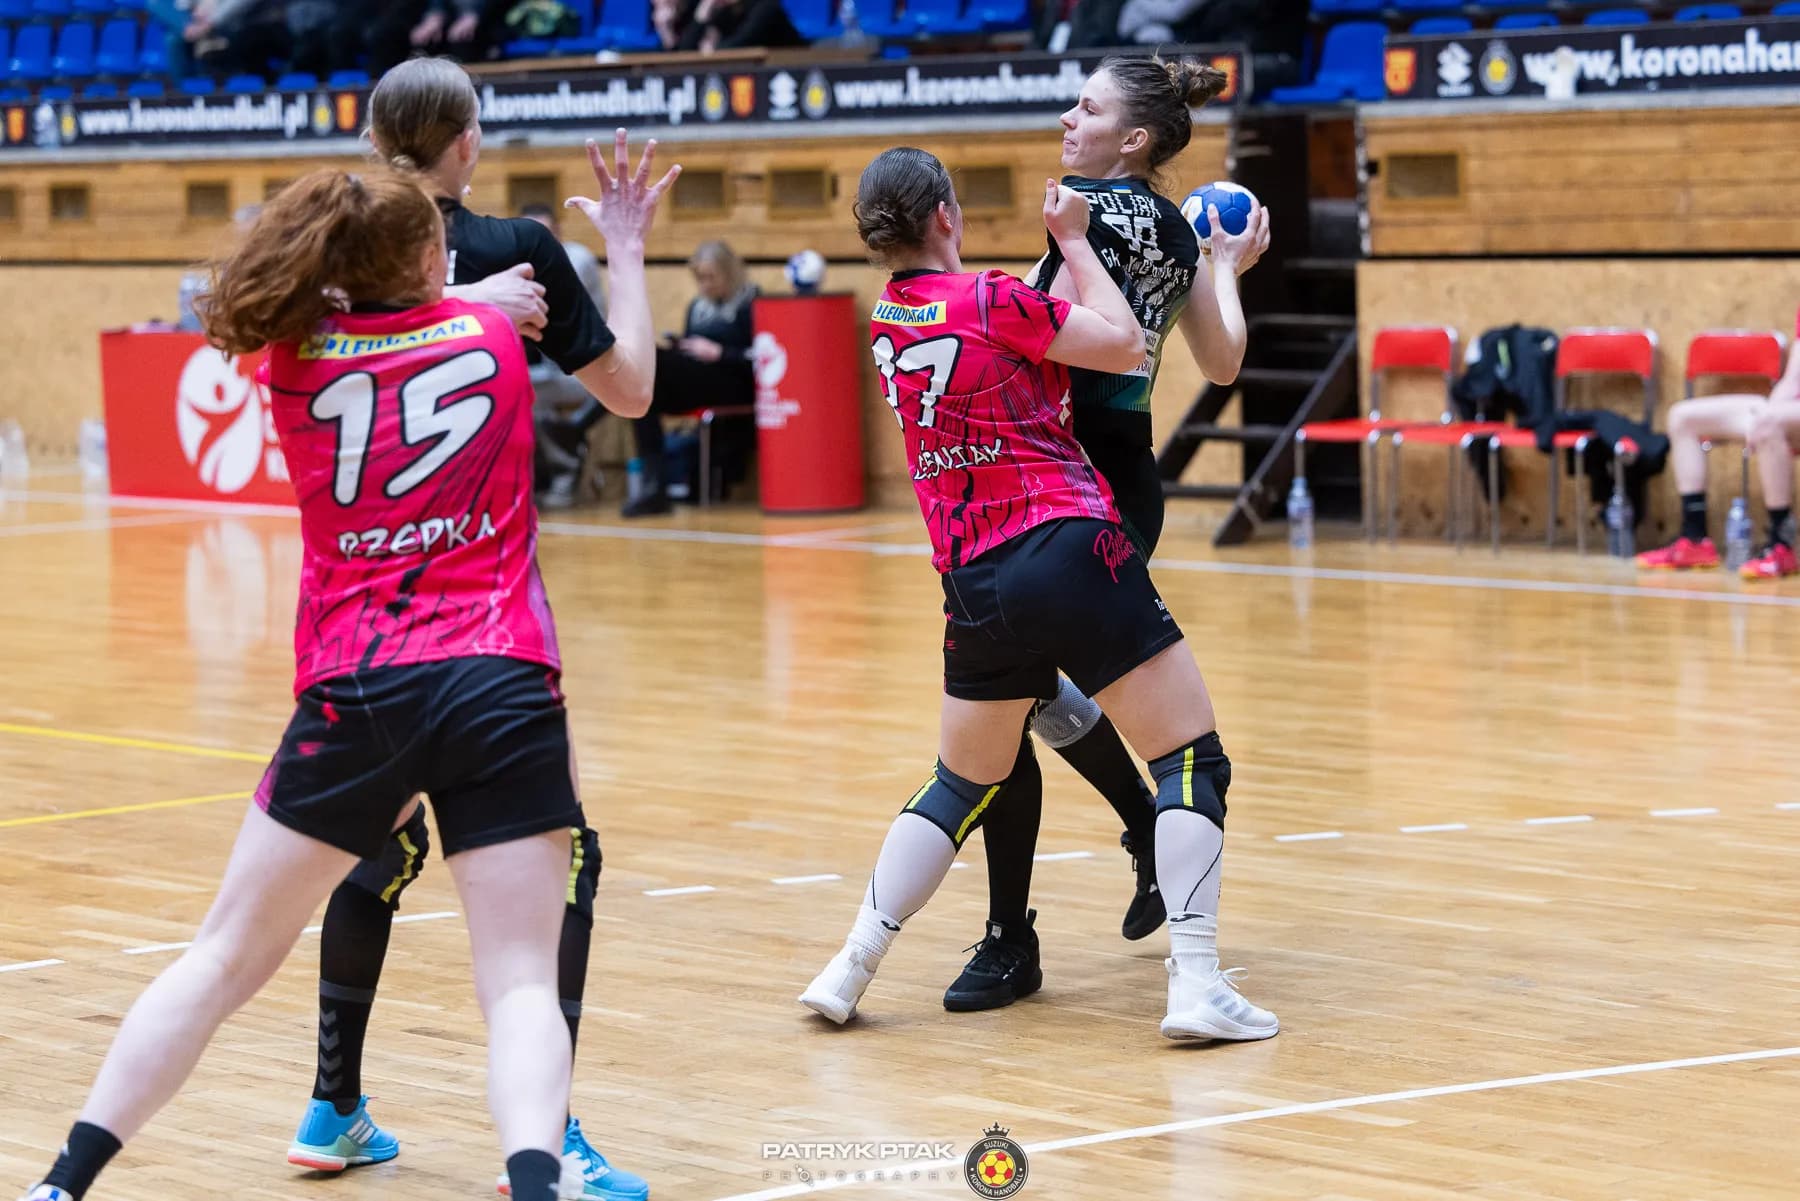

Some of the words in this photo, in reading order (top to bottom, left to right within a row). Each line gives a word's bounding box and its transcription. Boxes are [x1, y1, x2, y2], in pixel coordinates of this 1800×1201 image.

[880, 304, 938, 323] LEWIATAN
[309, 348, 498, 507] 15
[338, 512, 496, 561] RZEPKA
